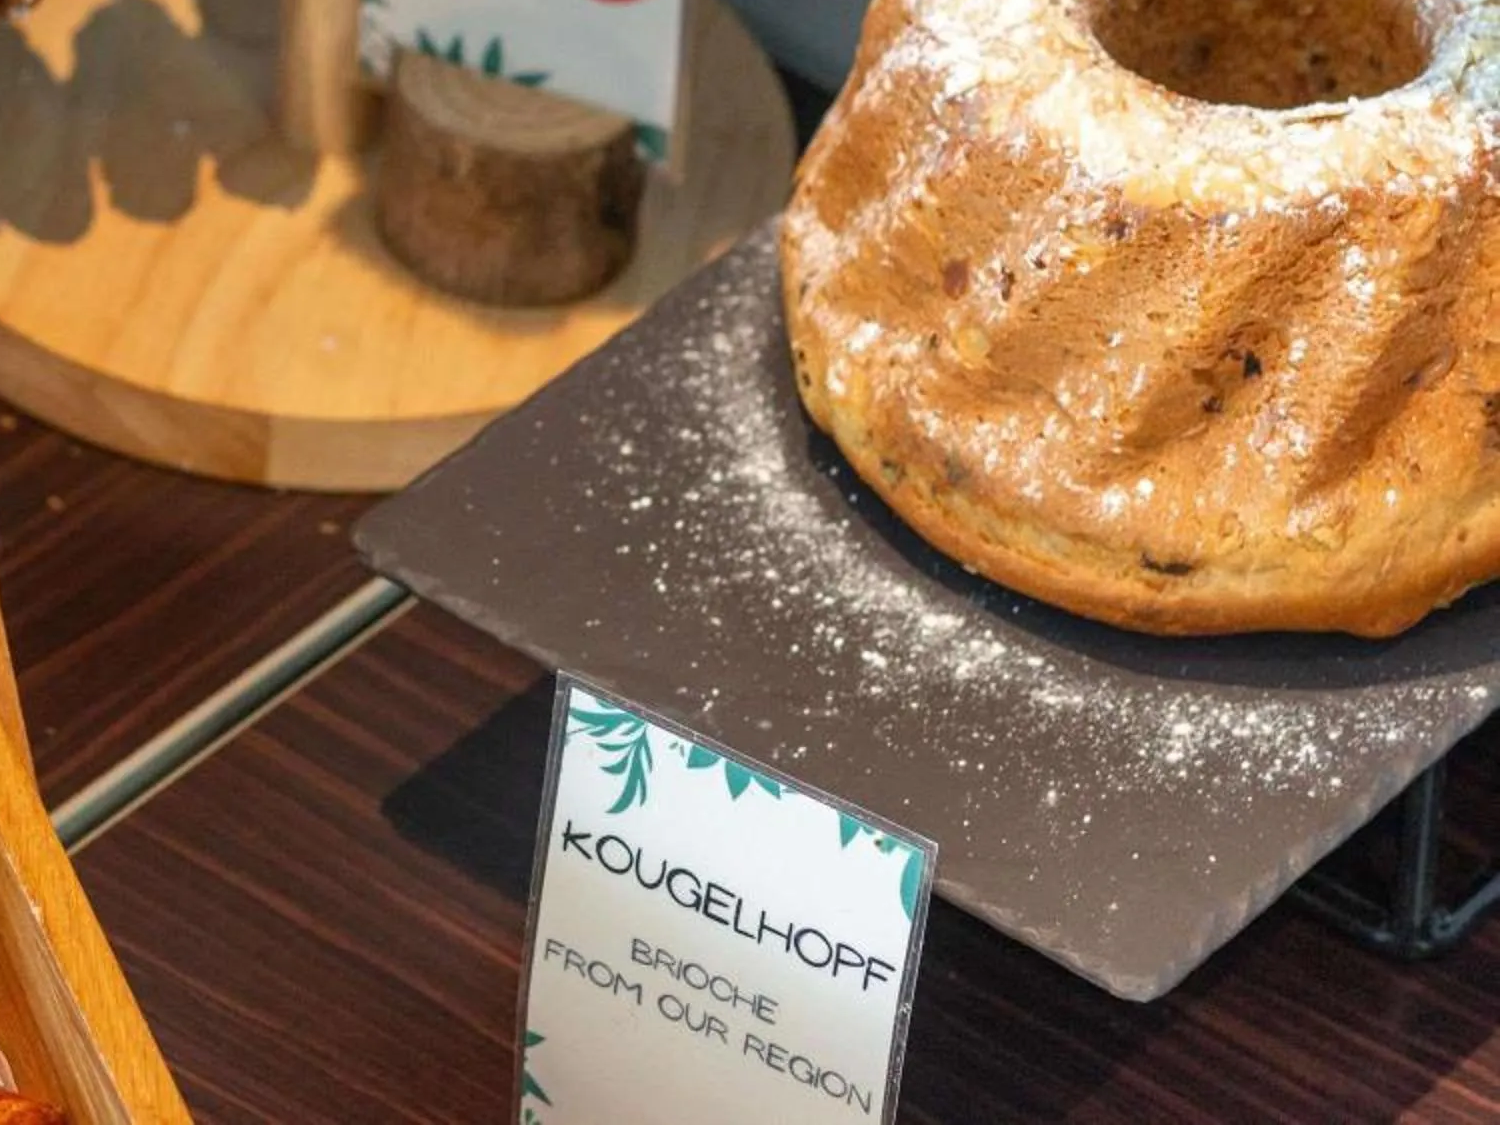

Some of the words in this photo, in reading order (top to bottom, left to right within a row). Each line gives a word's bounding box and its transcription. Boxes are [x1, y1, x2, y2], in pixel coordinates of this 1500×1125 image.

[561, 820, 896, 991] KOUGELHOPF
[631, 938, 779, 1025] BRIOCHE
[543, 938, 642, 1005] FROM
[658, 994, 729, 1045] OUR
[743, 1033, 873, 1115] REGION
